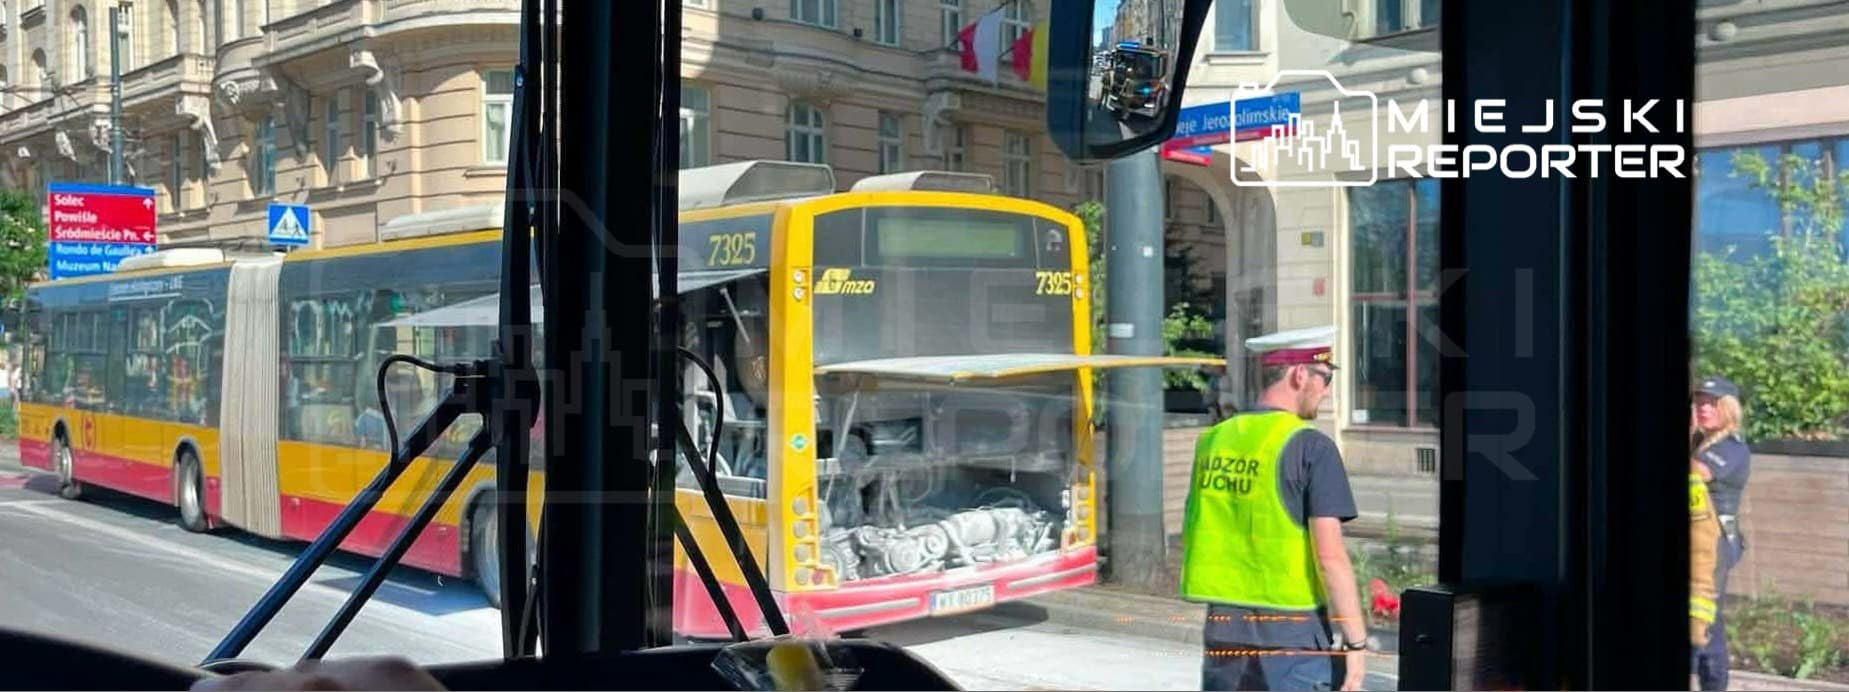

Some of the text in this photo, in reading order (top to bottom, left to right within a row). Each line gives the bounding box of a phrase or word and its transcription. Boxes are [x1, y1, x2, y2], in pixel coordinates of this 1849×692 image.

[1203, 105, 1290, 131] Jeroolimskie
[54, 193, 84, 207] Solec
[54, 210, 97, 223] Powiśle
[55, 224, 140, 241] Śródmieście Pn.
[56, 243, 88, 256] Rondo
[90, 243, 103, 256] de
[708, 232, 756, 266] 7325
[56, 260, 100, 272] Muzeum
[1036, 270, 1073, 294] 7325
[1200, 474, 1252, 495] UCHU
